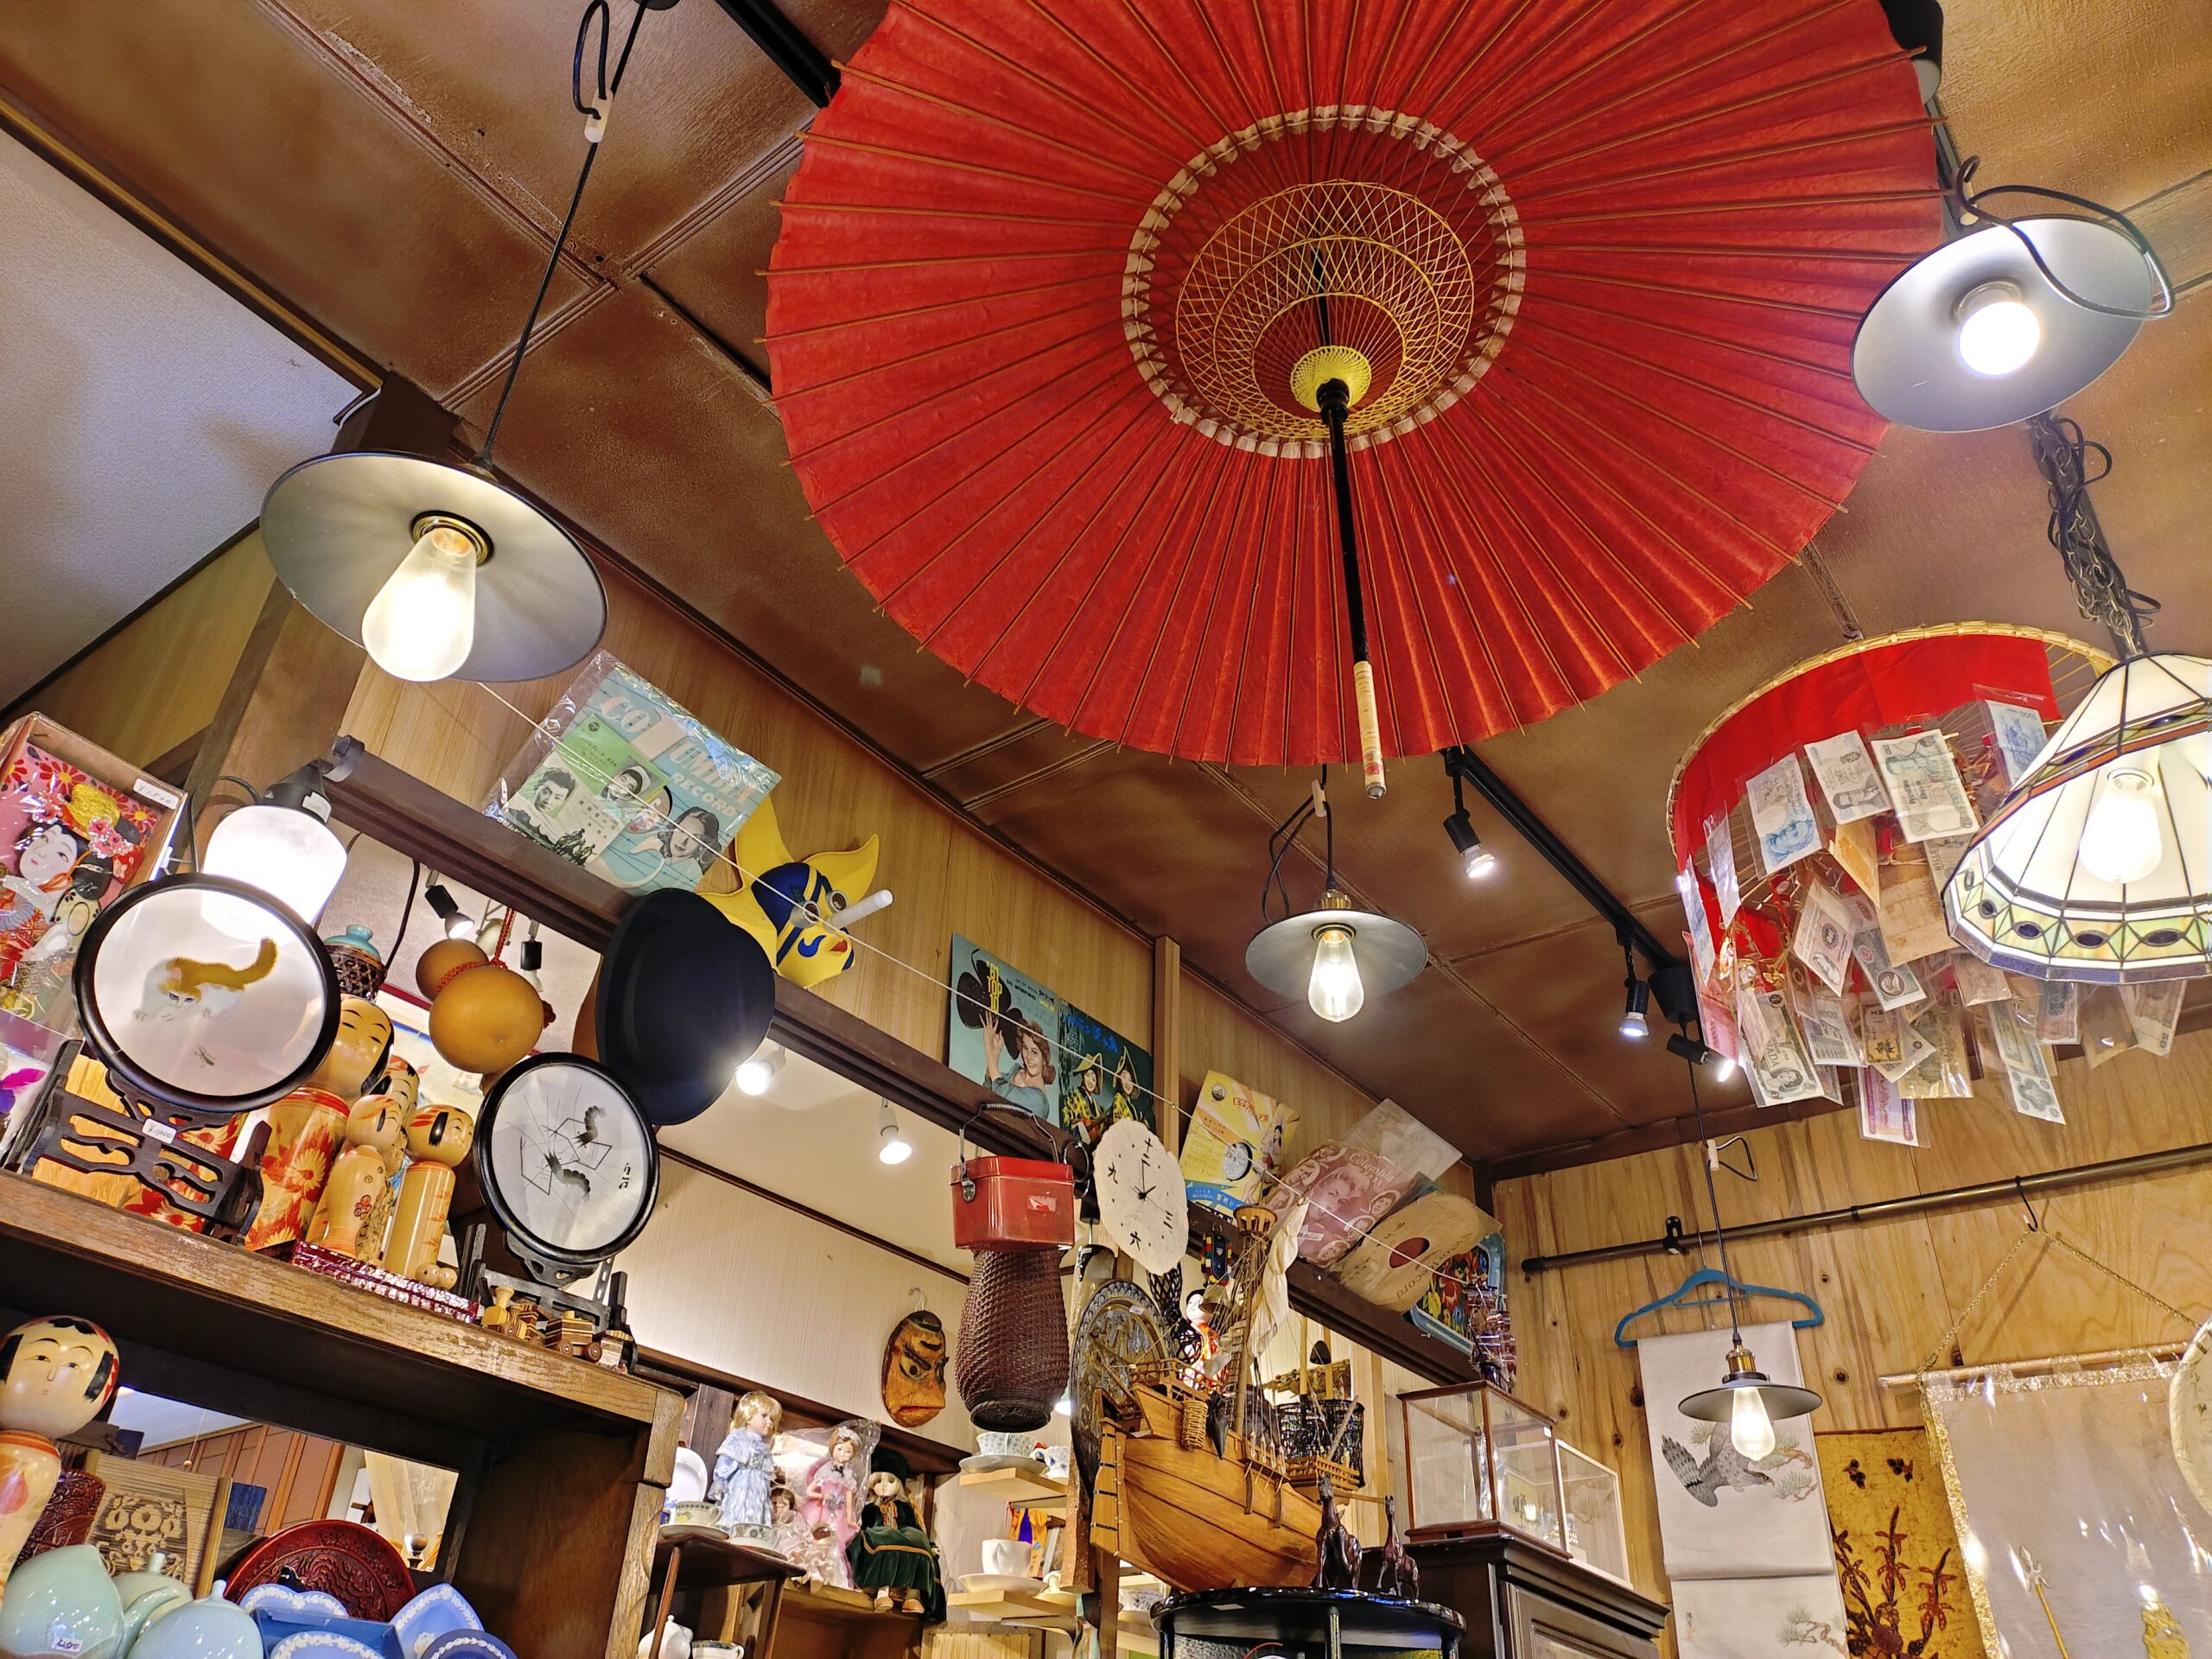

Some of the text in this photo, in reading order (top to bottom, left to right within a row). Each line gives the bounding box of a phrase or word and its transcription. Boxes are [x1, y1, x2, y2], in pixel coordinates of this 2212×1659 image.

[672, 772, 737, 817] RECORD
[987, 976, 1002, 996] TOP
[1014, 984, 1037, 1001] stereo
[989, 994, 1000, 1014] 10
[2160, 1033, 2170, 1049] 50
[1107, 1161, 1119, 1185] 九
[1349, 1153, 1395, 1183] Columbia
[1163, 1209, 1174, 1230] 三
[1129, 1230, 1141, 1252] 六
